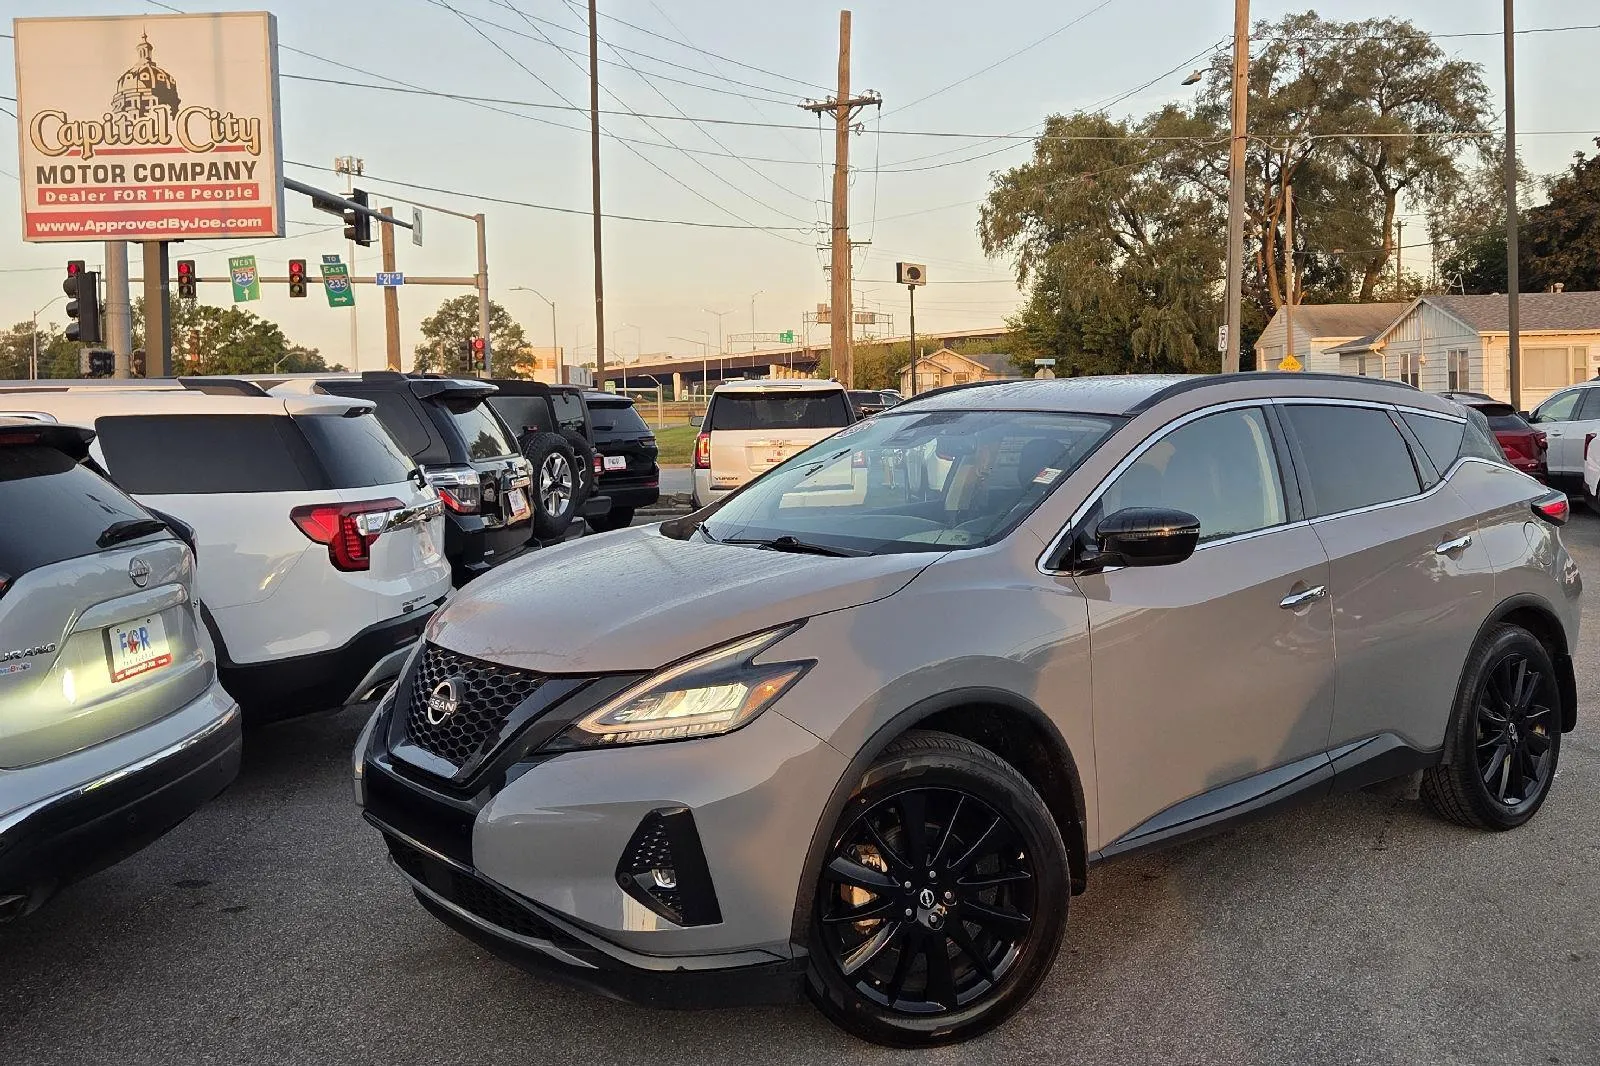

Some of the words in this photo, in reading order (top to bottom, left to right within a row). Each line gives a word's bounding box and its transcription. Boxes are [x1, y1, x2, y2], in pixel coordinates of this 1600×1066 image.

[30, 105, 172, 160] Capital
[176, 106, 260, 155] City
[37, 164, 126, 184] MOTOR
[134, 161, 257, 183] COMPANY
[45, 191, 106, 203] Dealer
[113, 190, 147, 201] FOR
[153, 189, 185, 200] The
[191, 187, 253, 200] People
[35, 217, 262, 234] www.ApprovedByJoe.com
[231, 258, 253, 267] WEST
[323, 266, 344, 274] EAST
[235, 271, 254, 283] 235
[328, 279, 347, 289] 235
[119, 626, 151, 657] FOR
